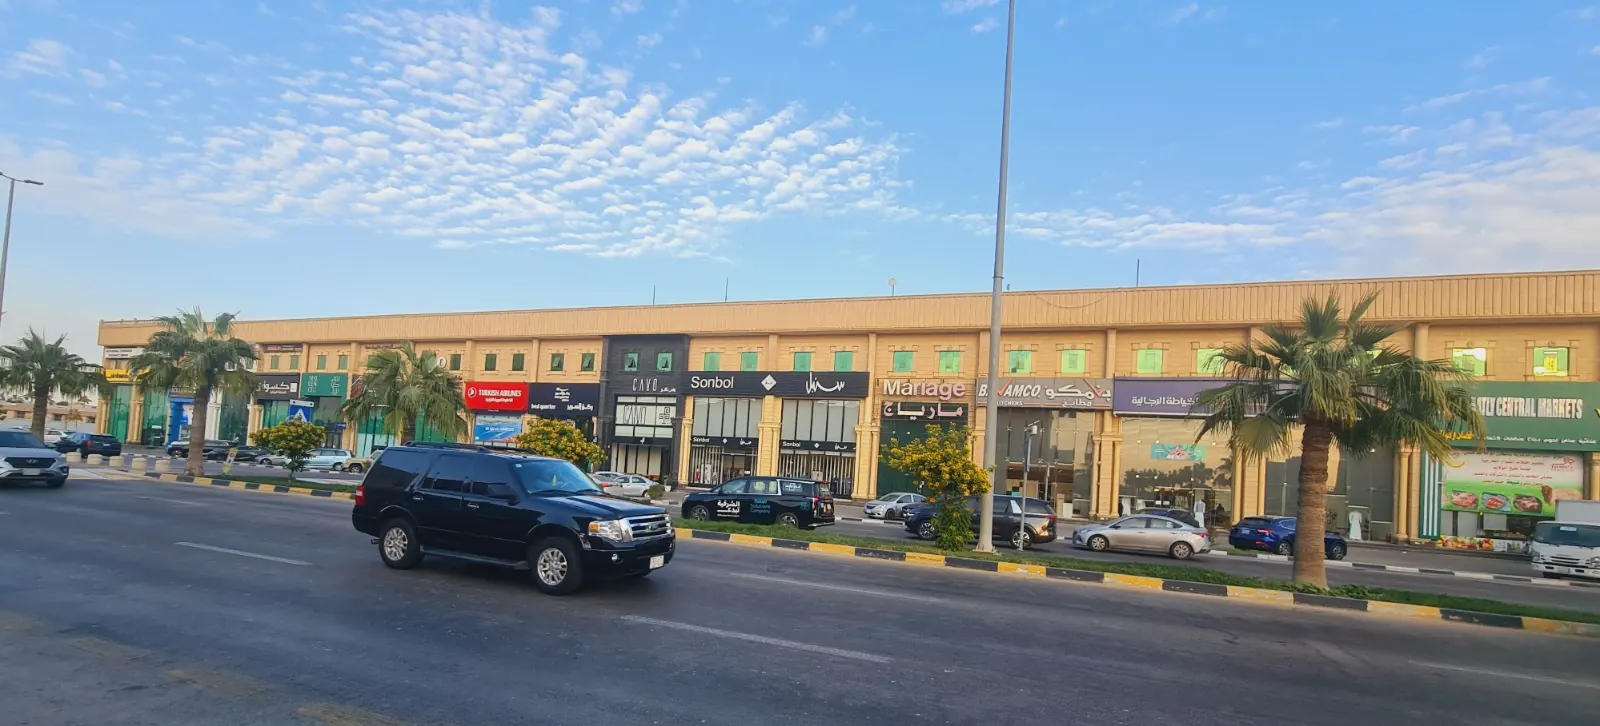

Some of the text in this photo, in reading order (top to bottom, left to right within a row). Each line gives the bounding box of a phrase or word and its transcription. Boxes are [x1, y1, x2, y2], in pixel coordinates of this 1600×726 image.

[691, 376, 734, 389] Sonbol
[883, 379, 966, 401] Mariage
[479, 389, 522, 397] TURKISH AIRLINES
[883, 401, 963, 421] مارياج
[1496, 397, 1536, 418] CENTRAL
[1538, 398, 1583, 419] MARKETS
[693, 436, 710, 444] Sonbol
